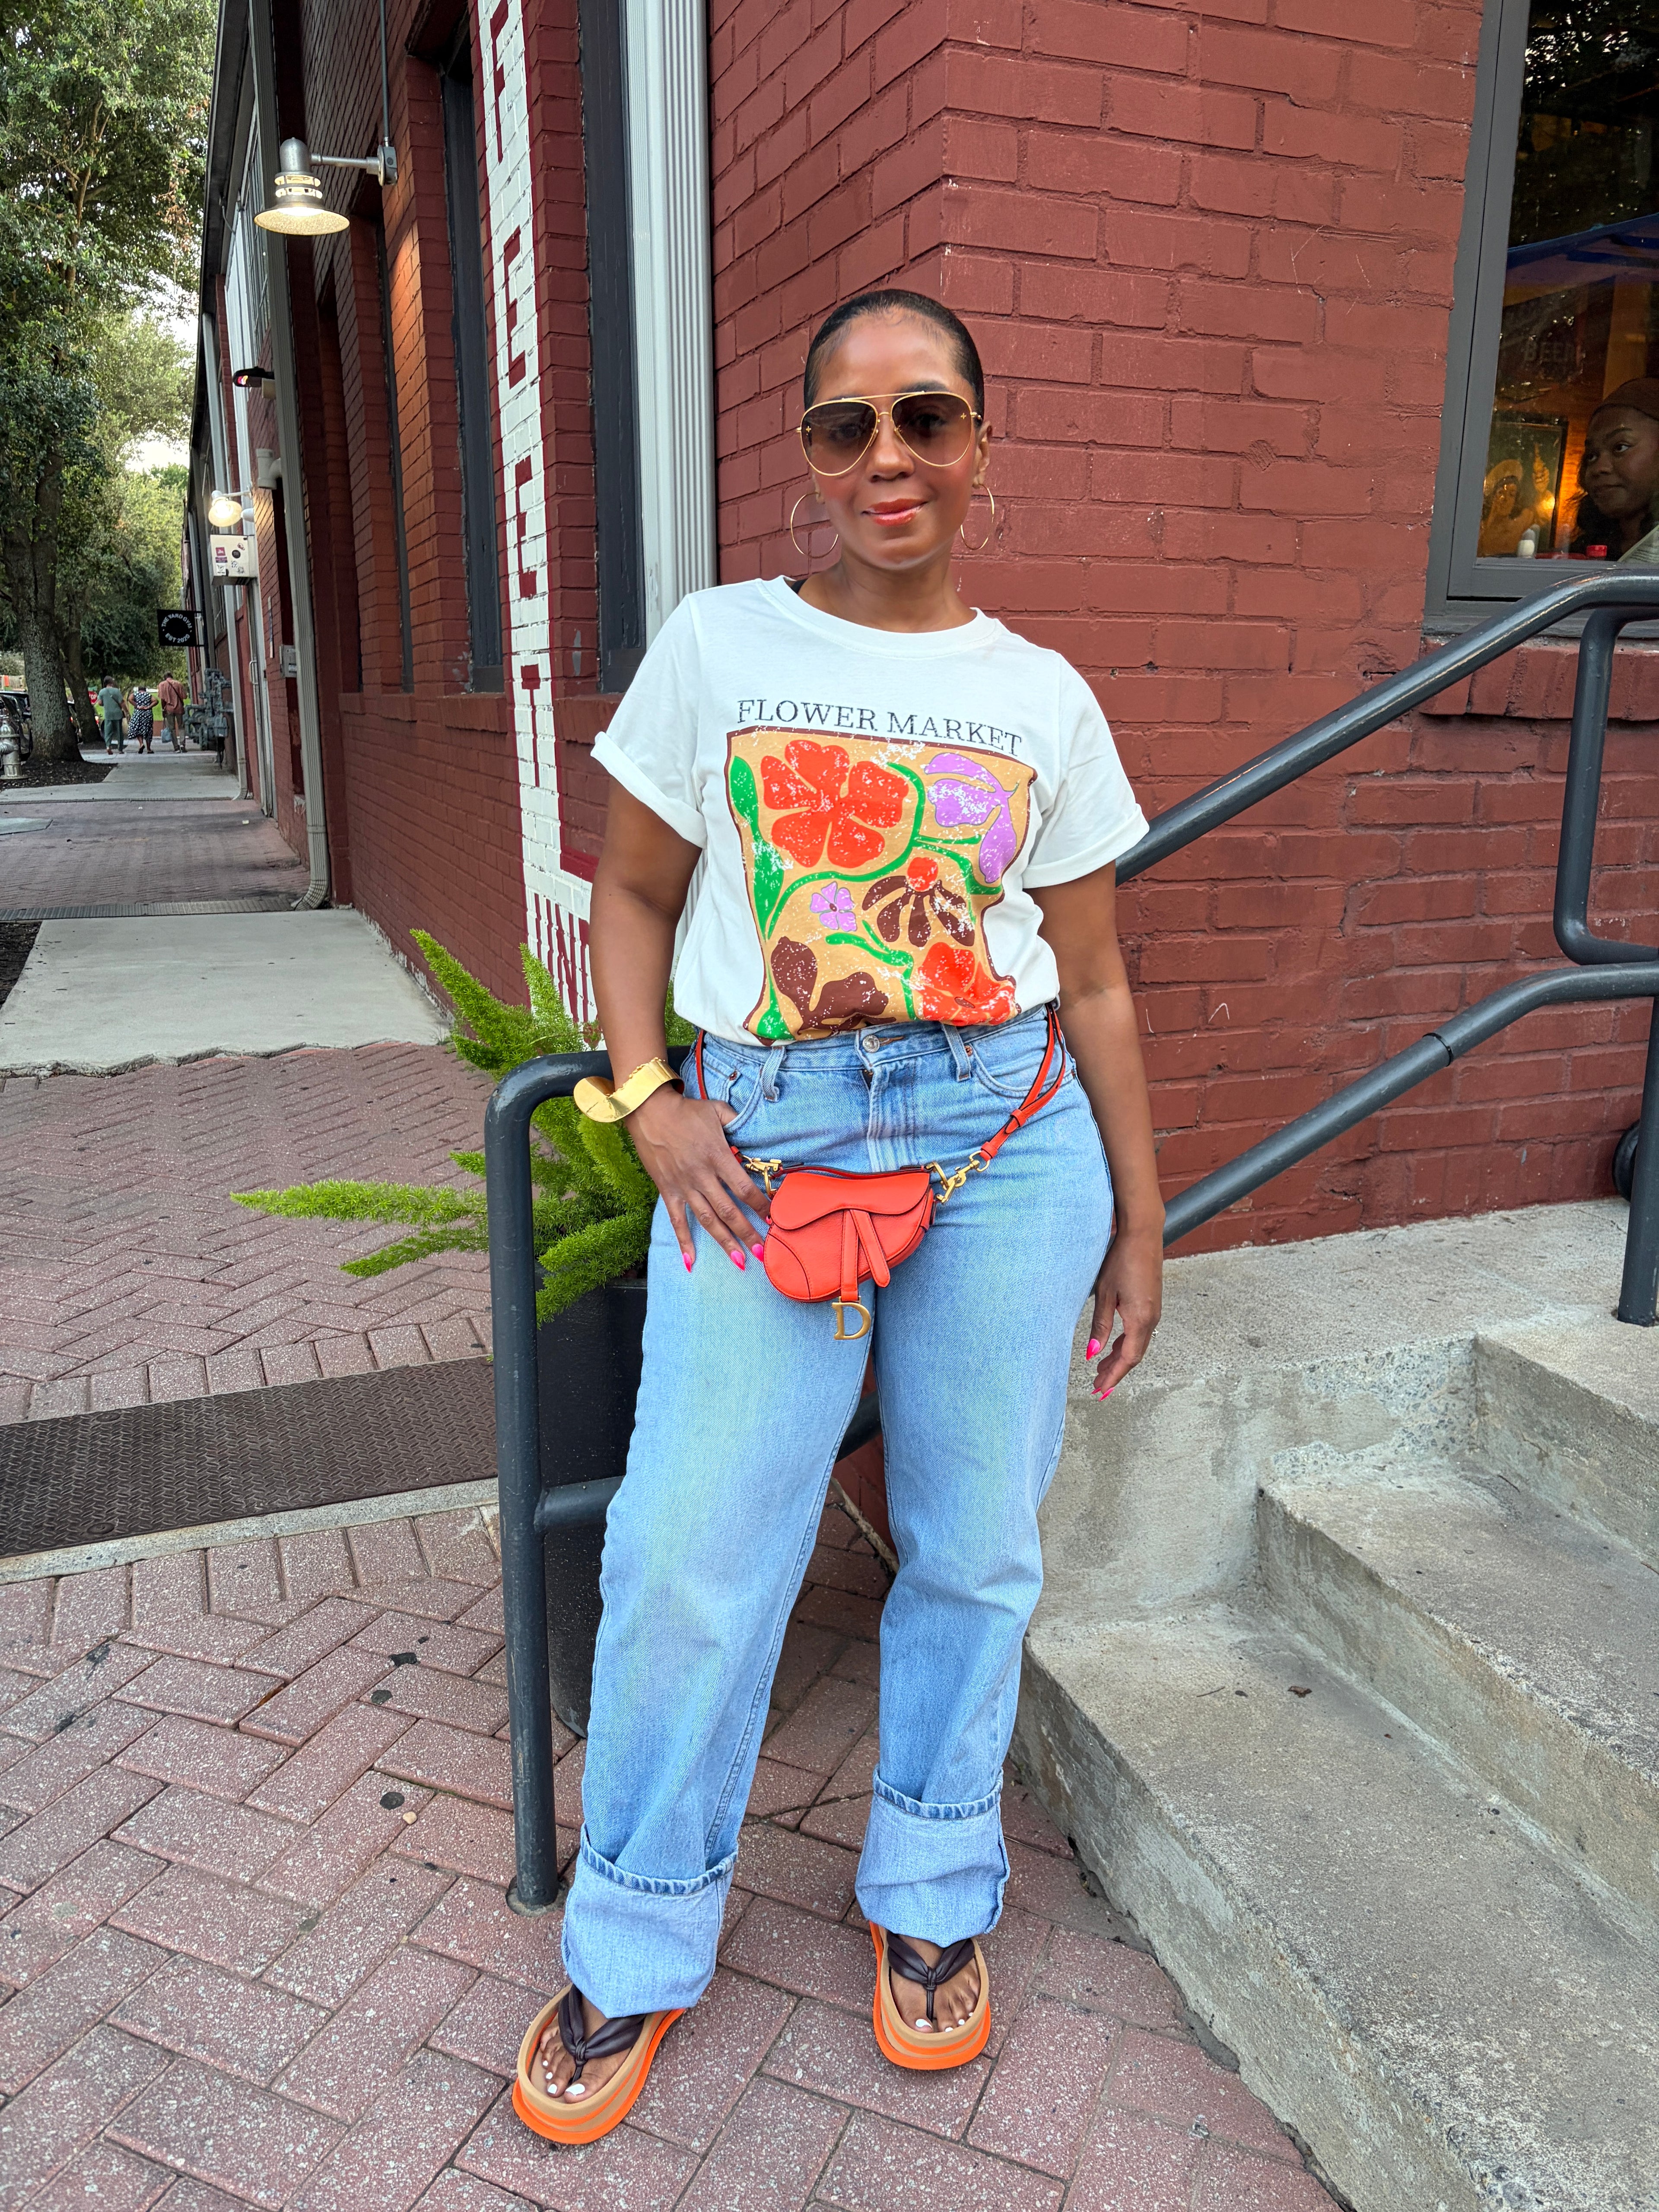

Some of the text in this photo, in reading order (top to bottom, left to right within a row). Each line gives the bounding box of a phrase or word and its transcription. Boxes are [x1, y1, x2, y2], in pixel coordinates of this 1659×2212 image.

[161, 617, 169, 627] THE
[183, 617, 192, 629] GYM
[165, 632, 190, 643] EST 2020
[737, 699, 1022, 757] FLOWER MARKET
[832, 1302, 871, 1340] D
